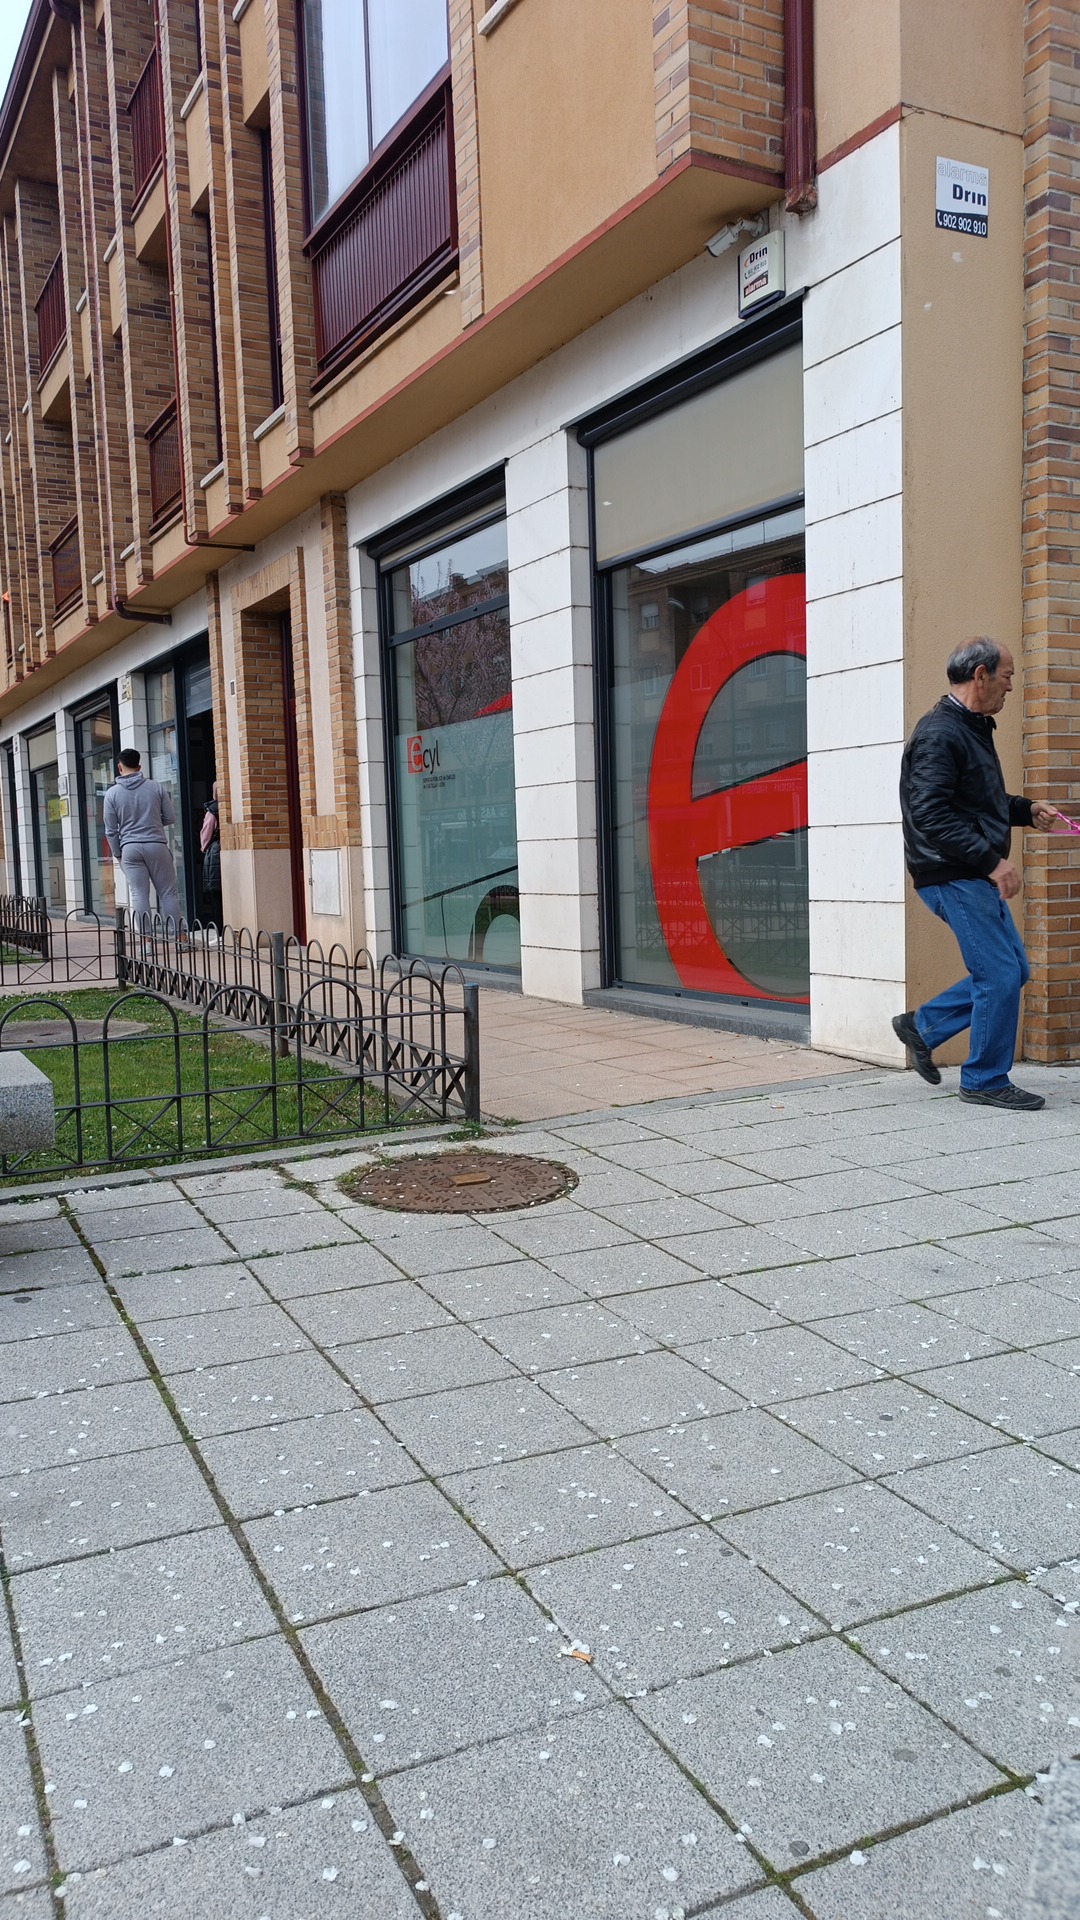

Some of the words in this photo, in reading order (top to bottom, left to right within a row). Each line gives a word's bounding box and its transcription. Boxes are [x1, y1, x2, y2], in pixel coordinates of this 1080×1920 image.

[937, 161, 987, 187] alarma
[952, 183, 987, 206] Drin
[943, 214, 956, 229] 902
[959, 217, 972, 232] 902
[973, 220, 987, 236] 910
[750, 247, 768, 264] Drin
